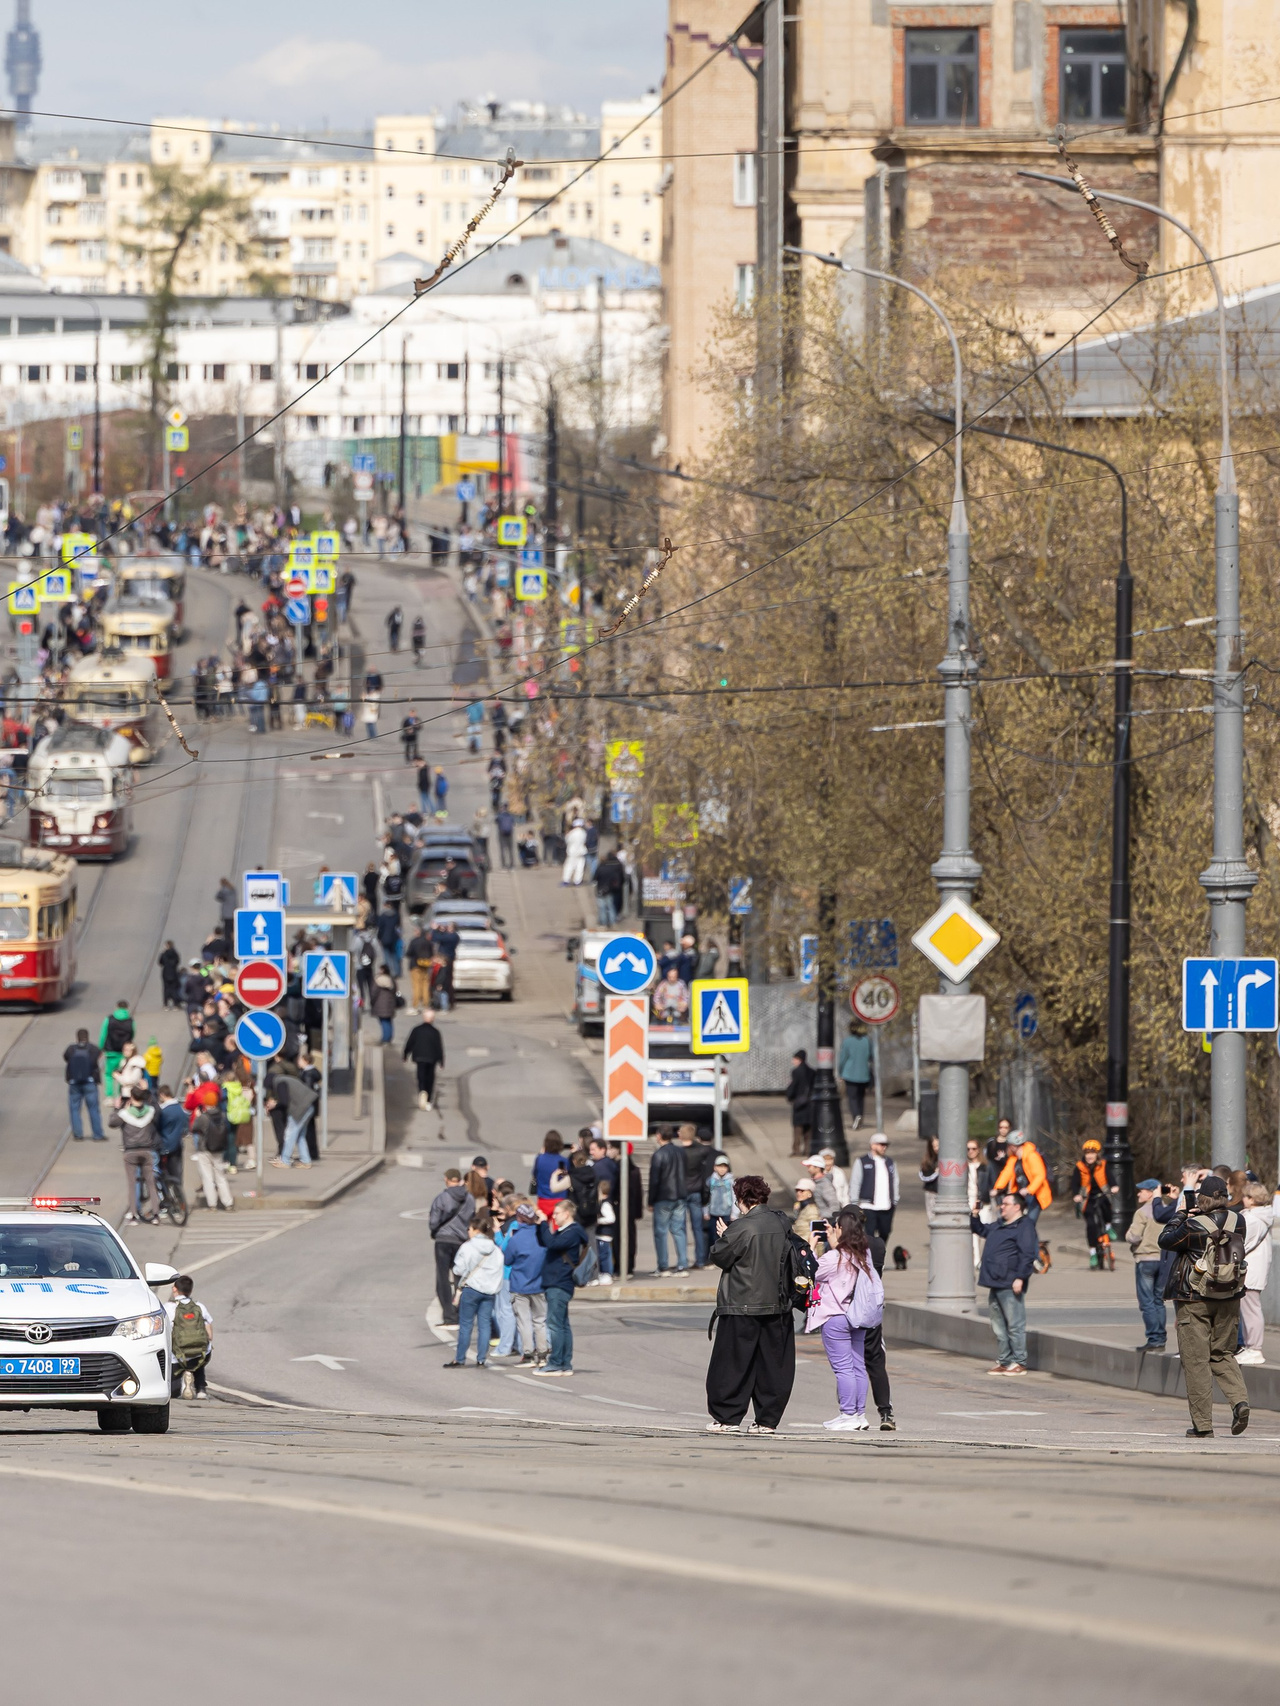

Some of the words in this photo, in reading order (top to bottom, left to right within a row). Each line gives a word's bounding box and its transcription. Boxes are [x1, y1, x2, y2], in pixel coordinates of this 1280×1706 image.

[863, 988, 889, 1008] 40
[19, 1360, 53, 1373] 7408
[61, 1360, 75, 1370] 99
